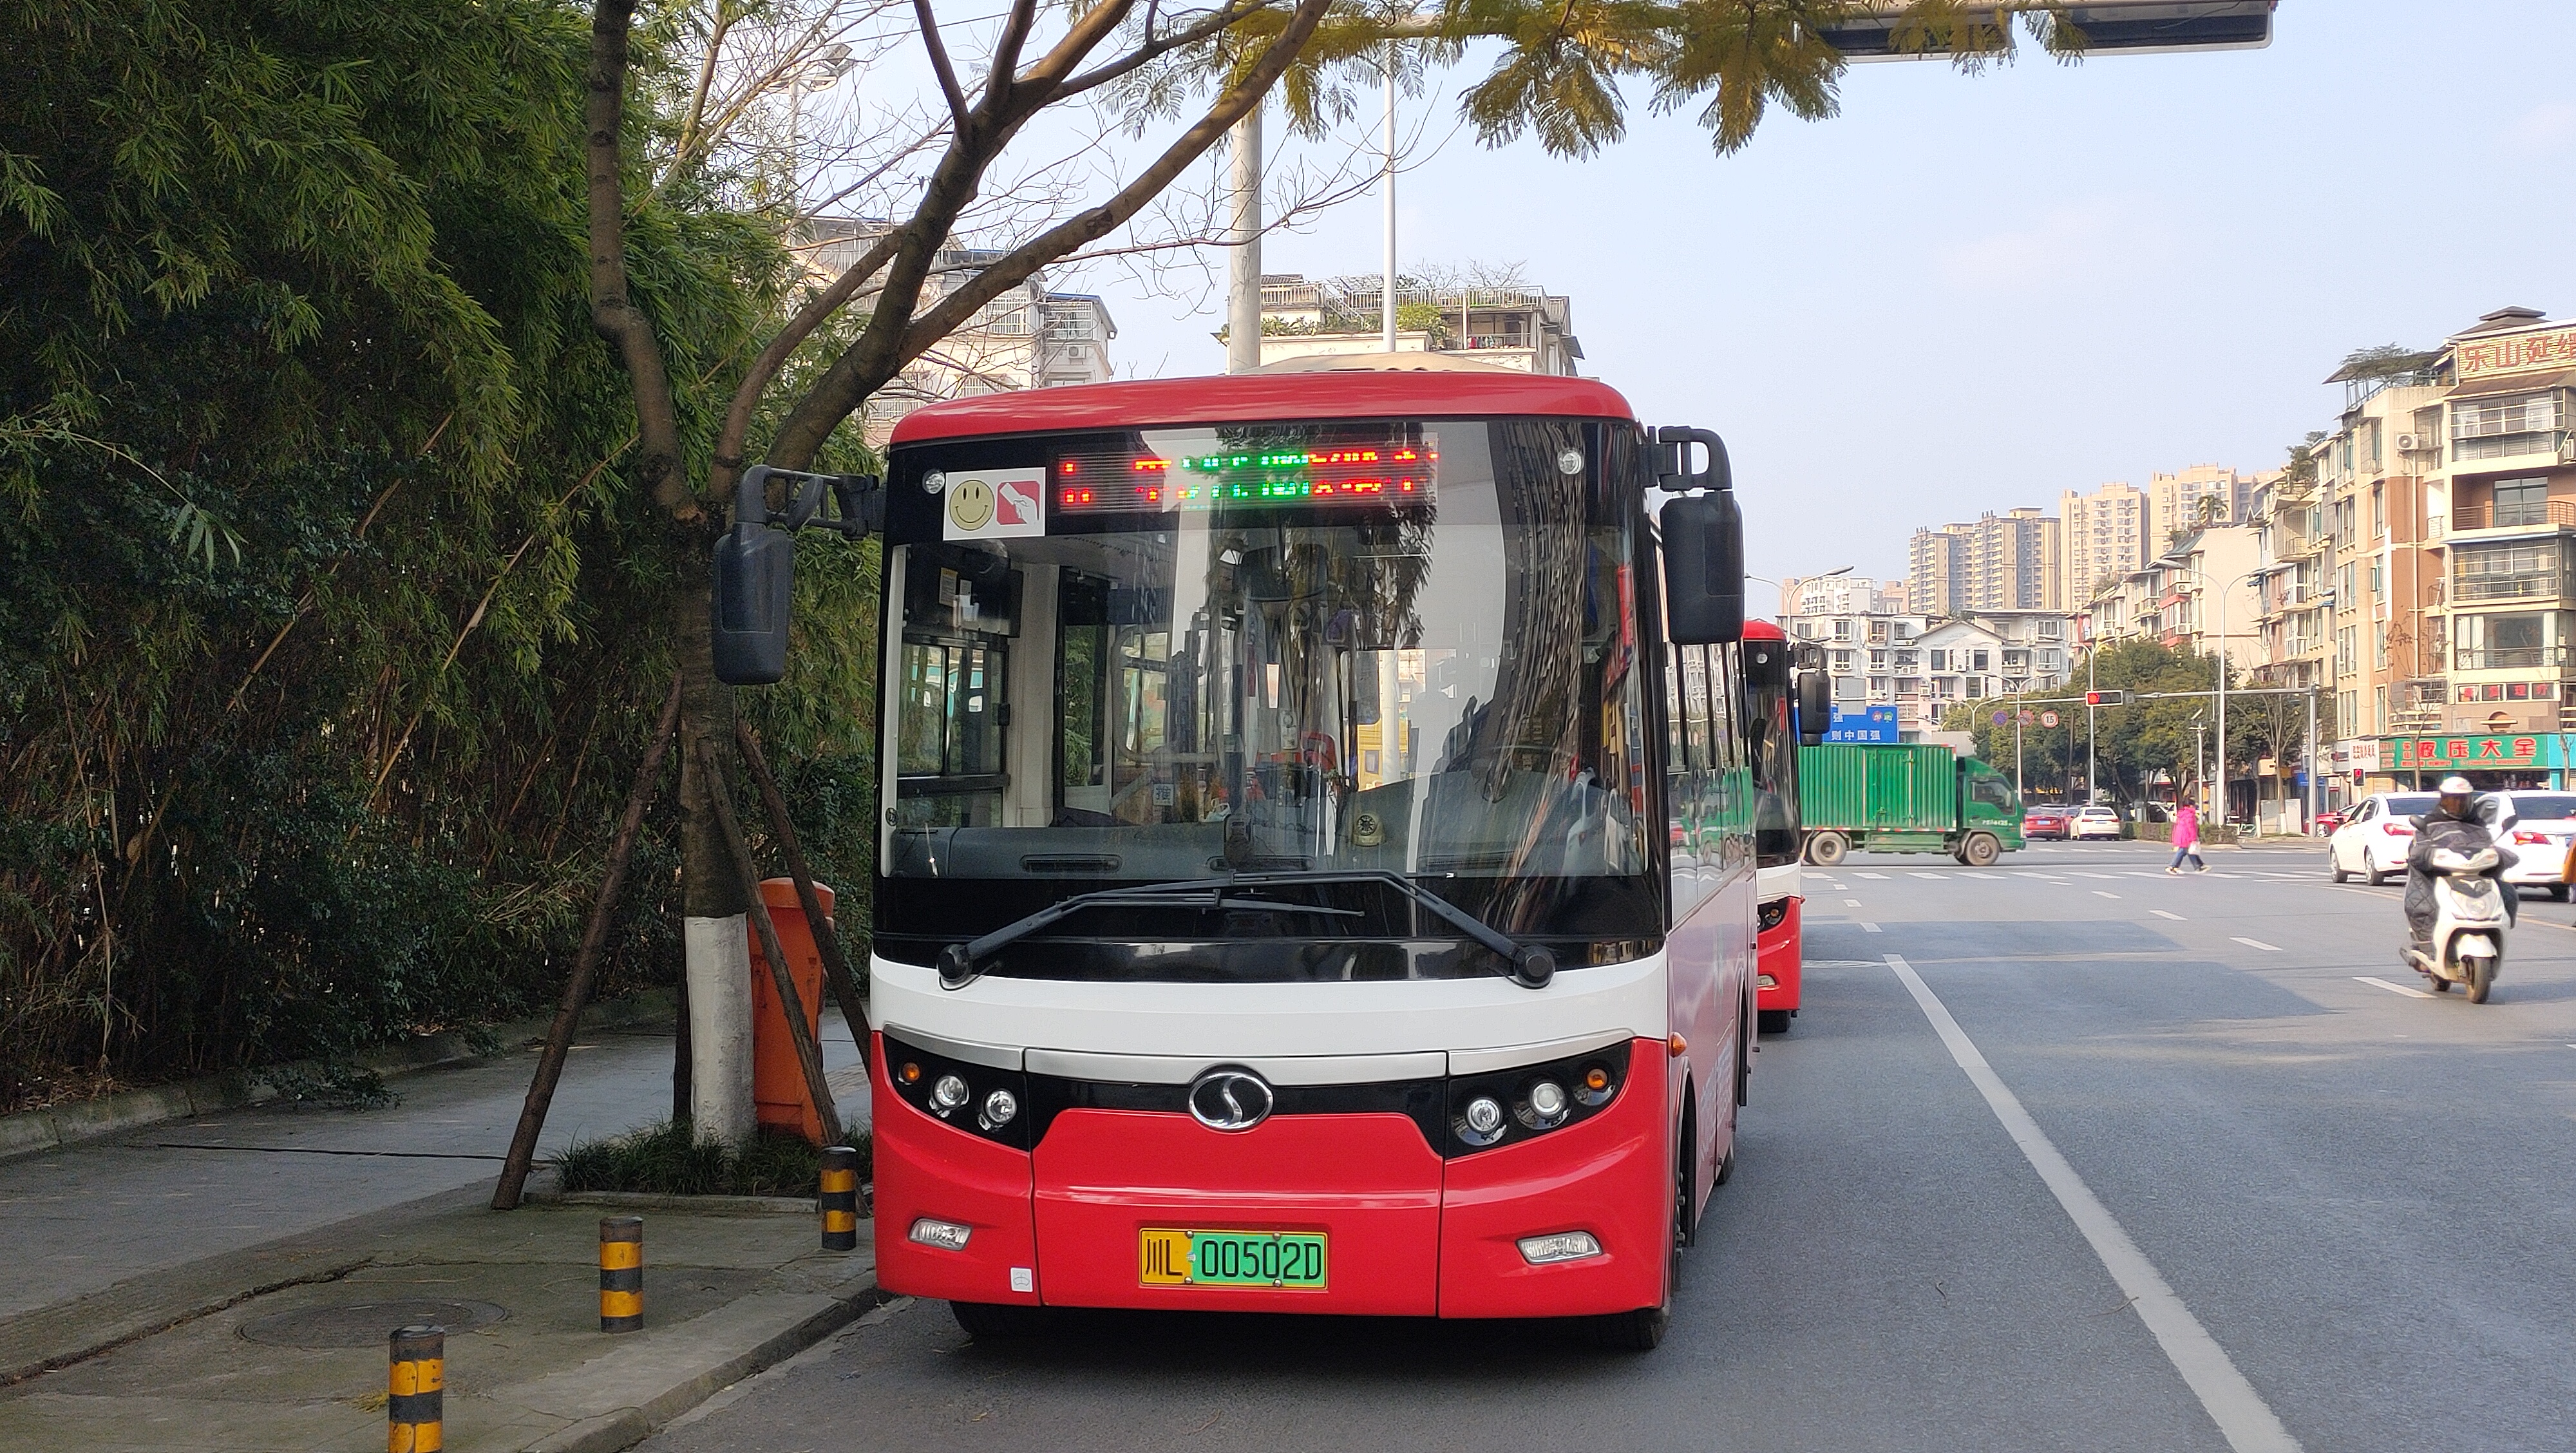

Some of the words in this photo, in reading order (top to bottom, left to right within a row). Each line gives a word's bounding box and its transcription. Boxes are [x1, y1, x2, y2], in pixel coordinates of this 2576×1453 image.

[1832, 730, 1881, 741] 则中国强
[1145, 1238, 1183, 1276] 川L
[1201, 1240, 1322, 1280] 00502D
